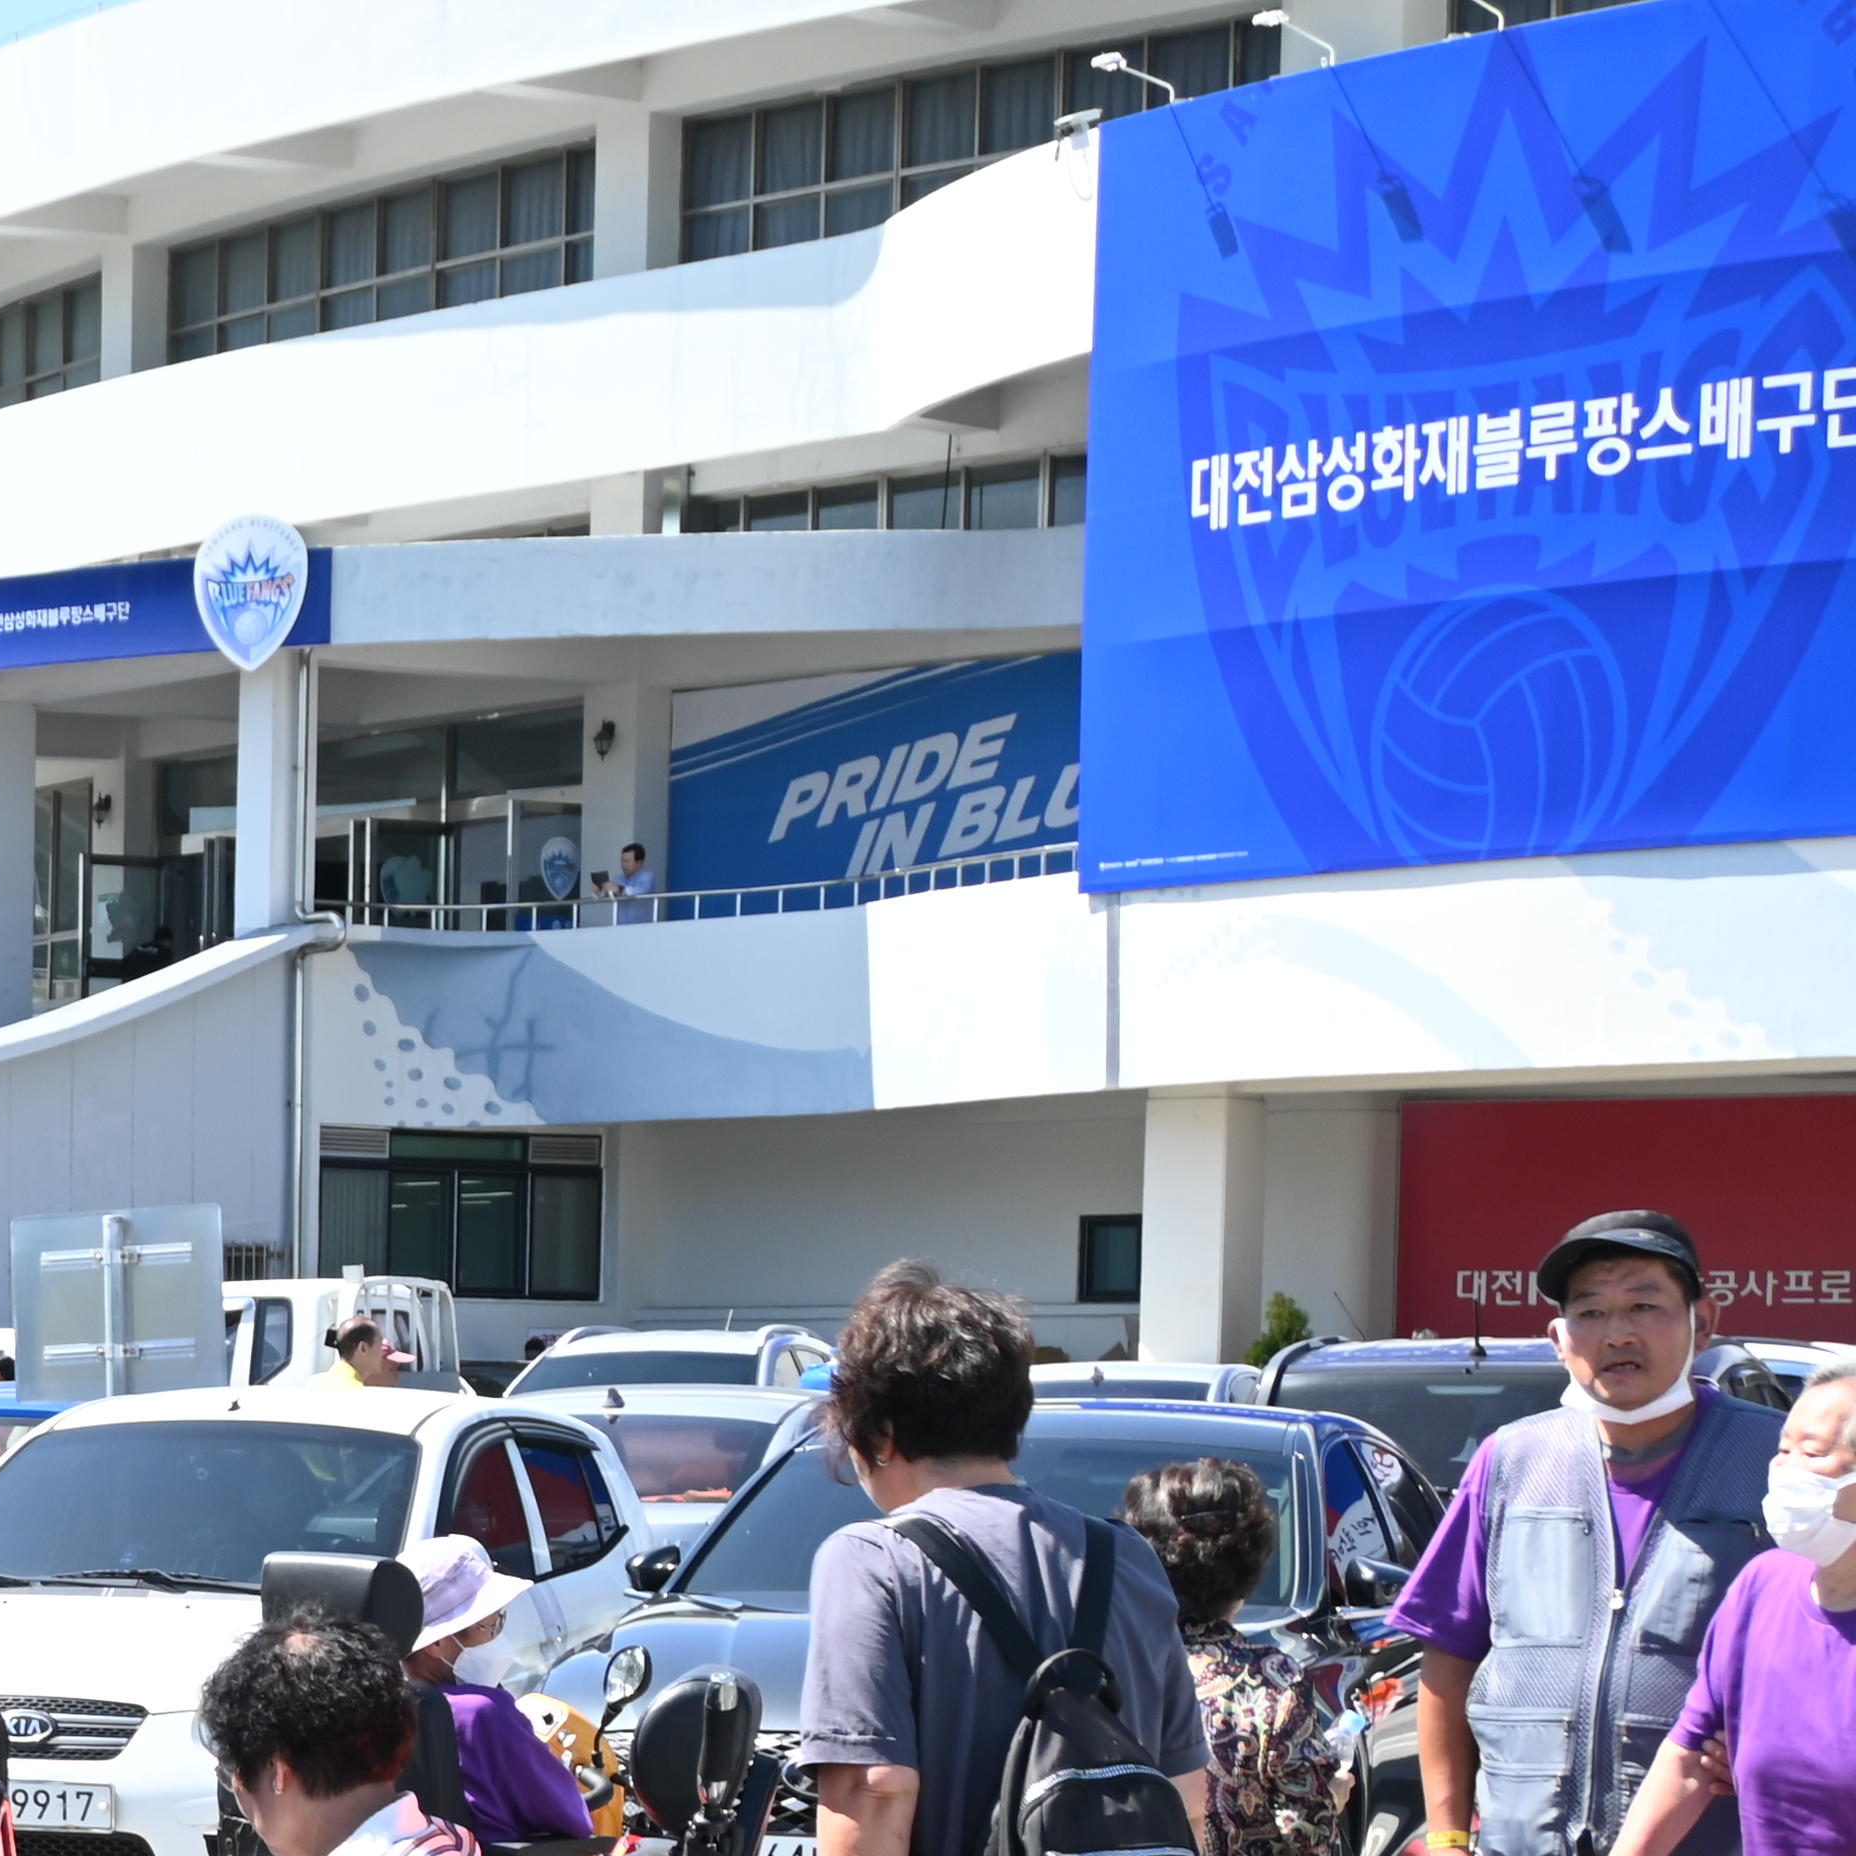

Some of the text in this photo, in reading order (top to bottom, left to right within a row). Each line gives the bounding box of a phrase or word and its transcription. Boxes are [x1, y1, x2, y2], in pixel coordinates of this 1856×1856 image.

[767, 712, 1018, 844] PRIDE
[845, 801, 937, 878] IN
[11, 1788, 94, 1822] 9917
